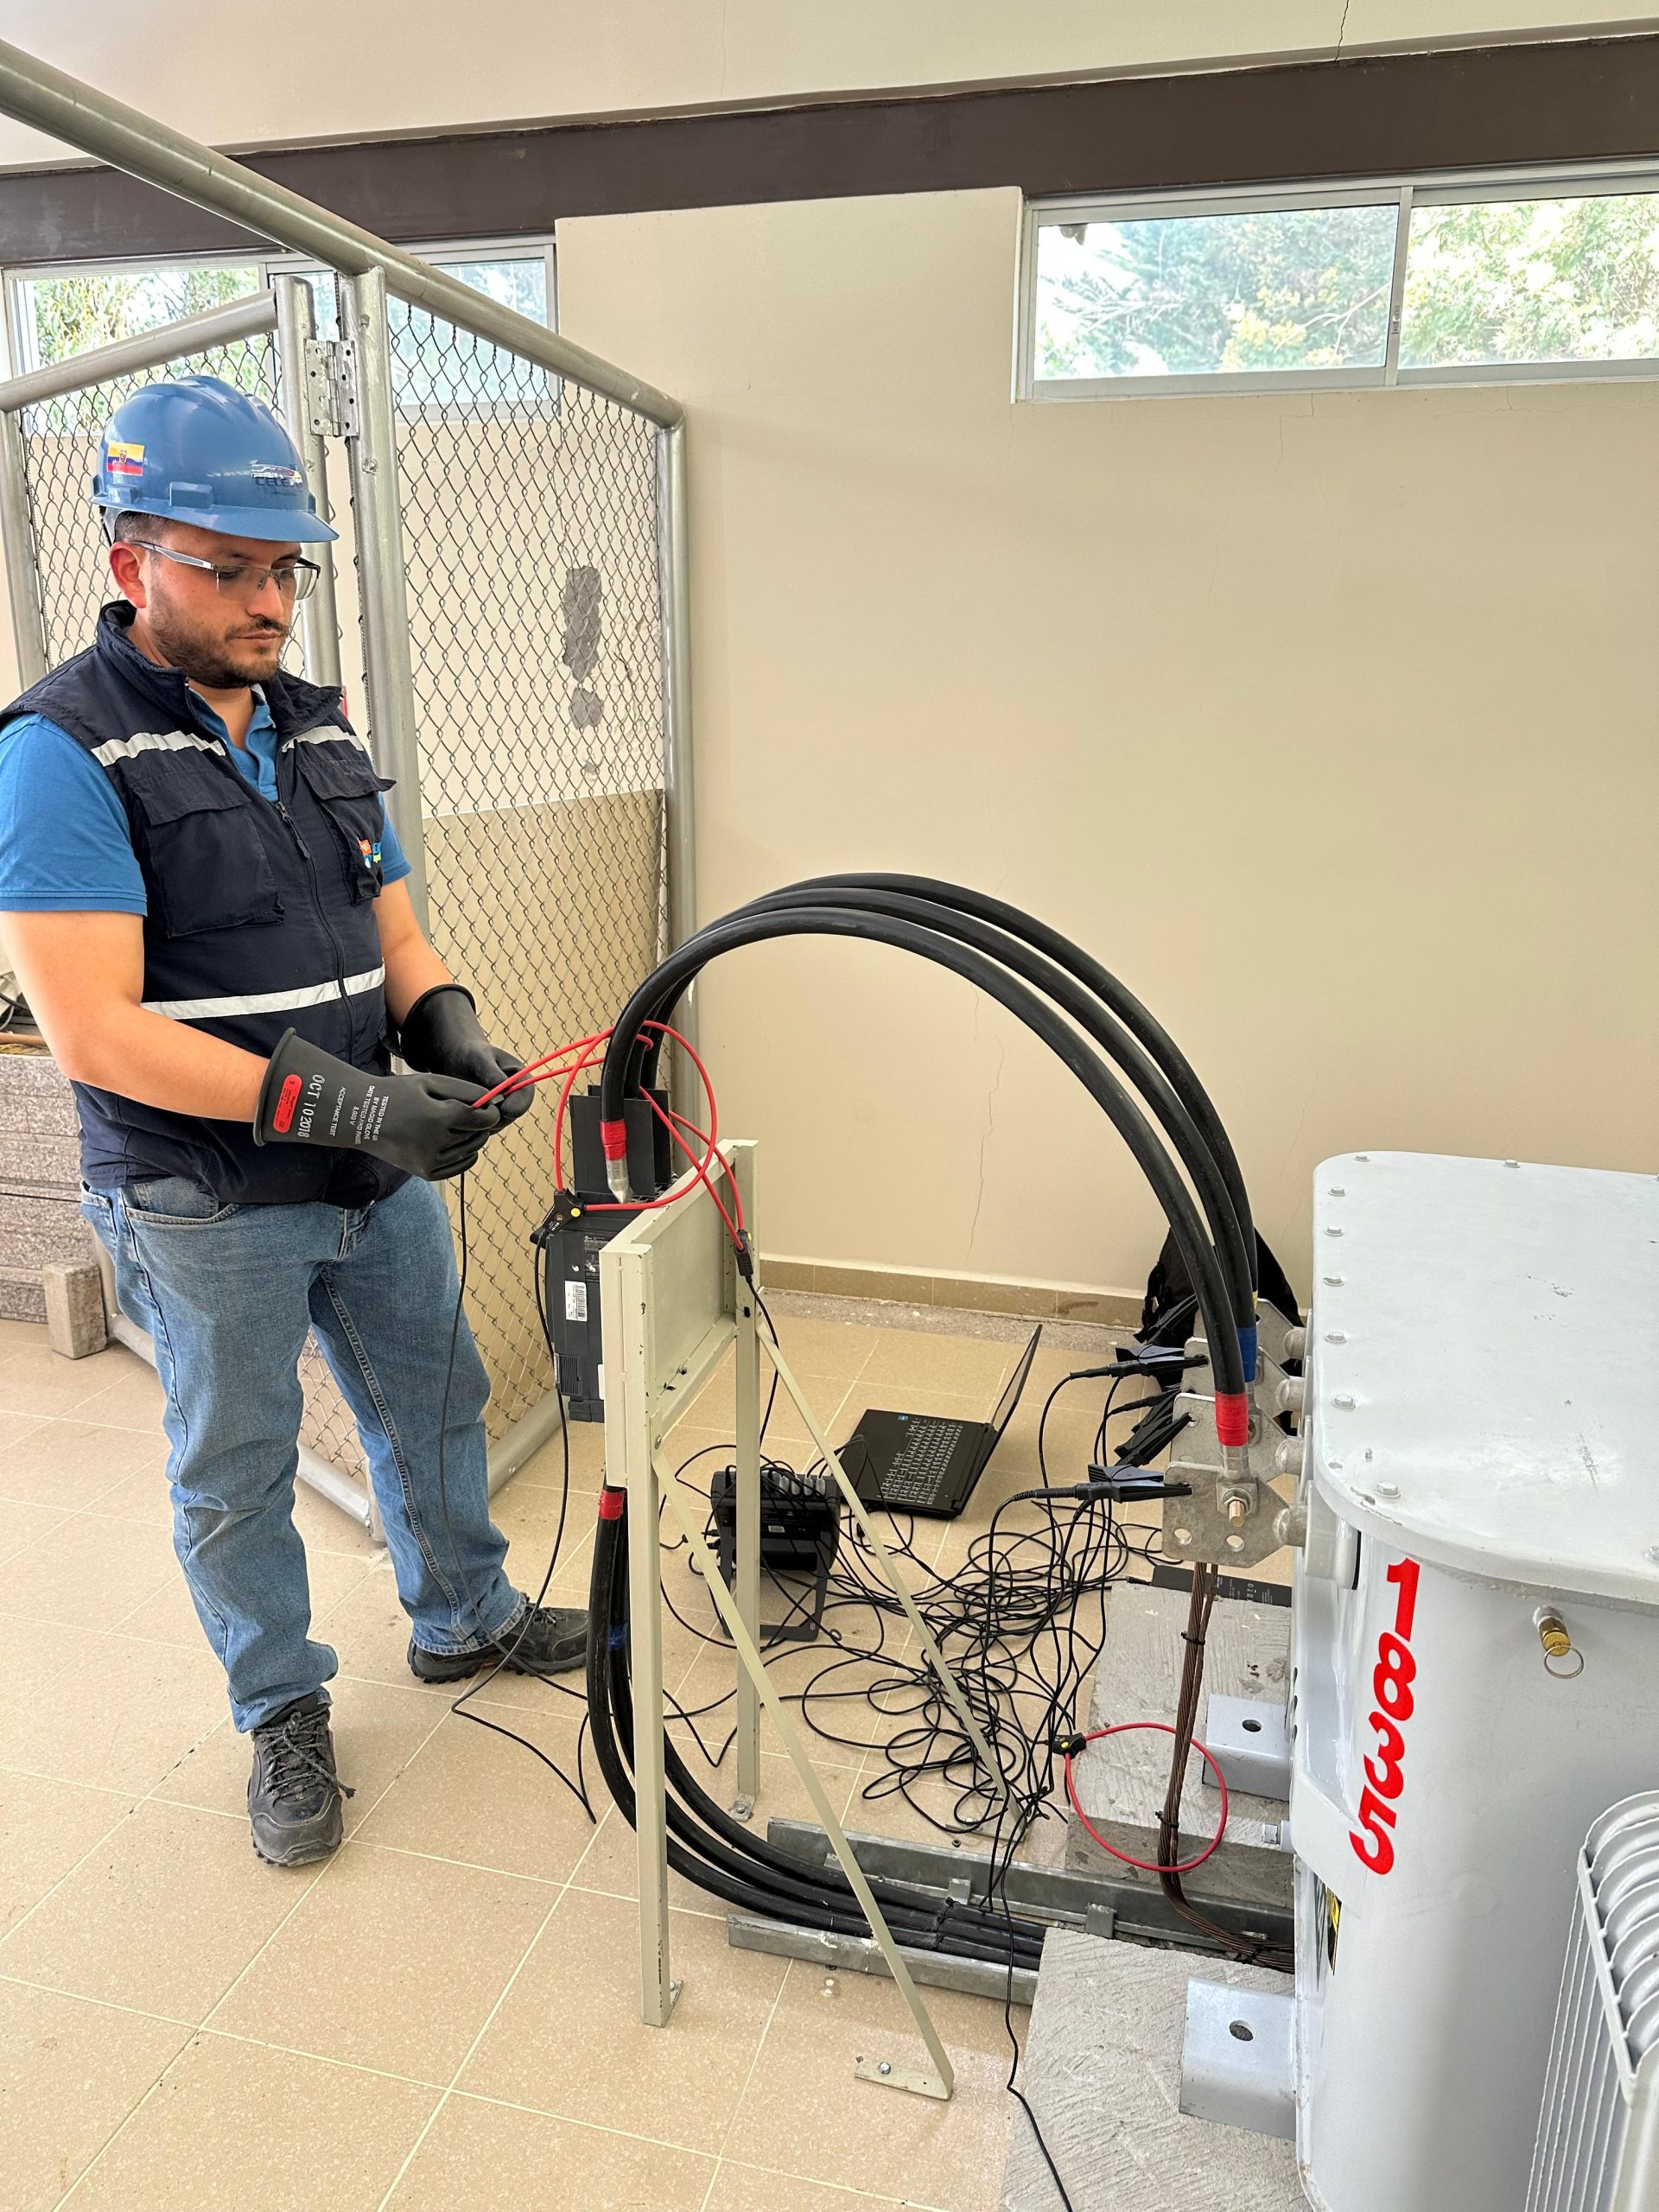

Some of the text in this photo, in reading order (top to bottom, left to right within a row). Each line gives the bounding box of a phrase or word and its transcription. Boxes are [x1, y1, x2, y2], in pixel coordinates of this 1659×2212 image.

[365, 1085, 376, 1098] DATE
[373, 1096, 380, 1105] BY
[296, 1074, 326, 1138] OCT 10 2018
[328, 1086, 346, 1137] ACCEPTANCE TEST
[359, 1097, 372, 1119] TESTED
[378, 1096, 389, 1117] TESTED
[372, 1124, 381, 1135] THE
